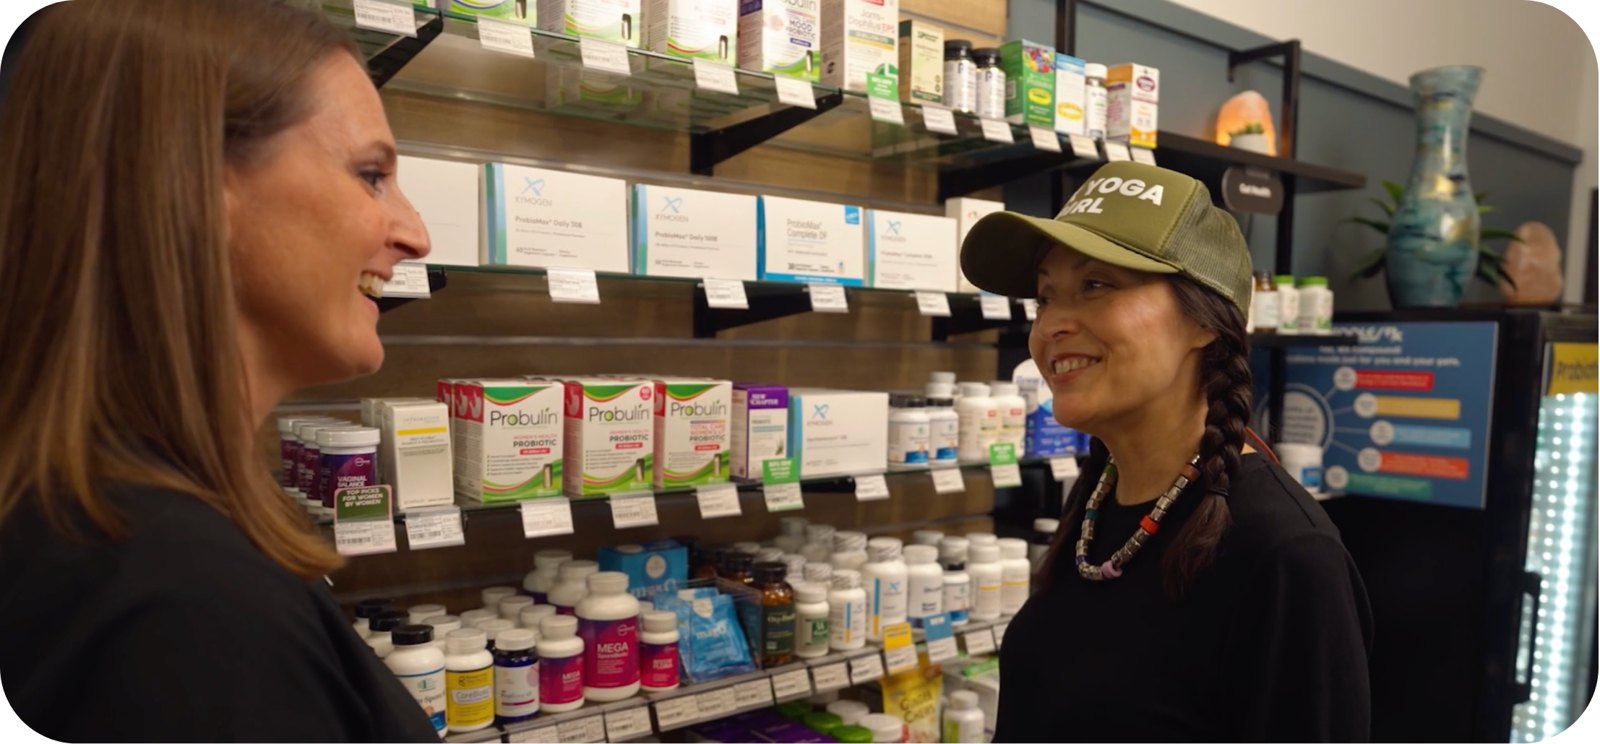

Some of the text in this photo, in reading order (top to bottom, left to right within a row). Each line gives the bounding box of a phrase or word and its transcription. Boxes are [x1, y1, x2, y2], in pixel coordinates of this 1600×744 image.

[1084, 177, 1164, 206] YOGA
[553, 219, 569, 228] Daily
[787, 227, 818, 240] Complete
[589, 404, 650, 422] Probulin
[671, 400, 727, 417] Probulin
[490, 407, 558, 426] Probulin
[609, 433, 649, 442] PROBIOTIC
[689, 434, 726, 442] PROBIOTIC
[513, 439, 557, 447] PROBIOTIC
[357, 493, 384, 501] WOMEN
[355, 499, 382, 507] WOMEN
[597, 642, 628, 653] MEGA
[563, 671, 580, 680] MEGA
